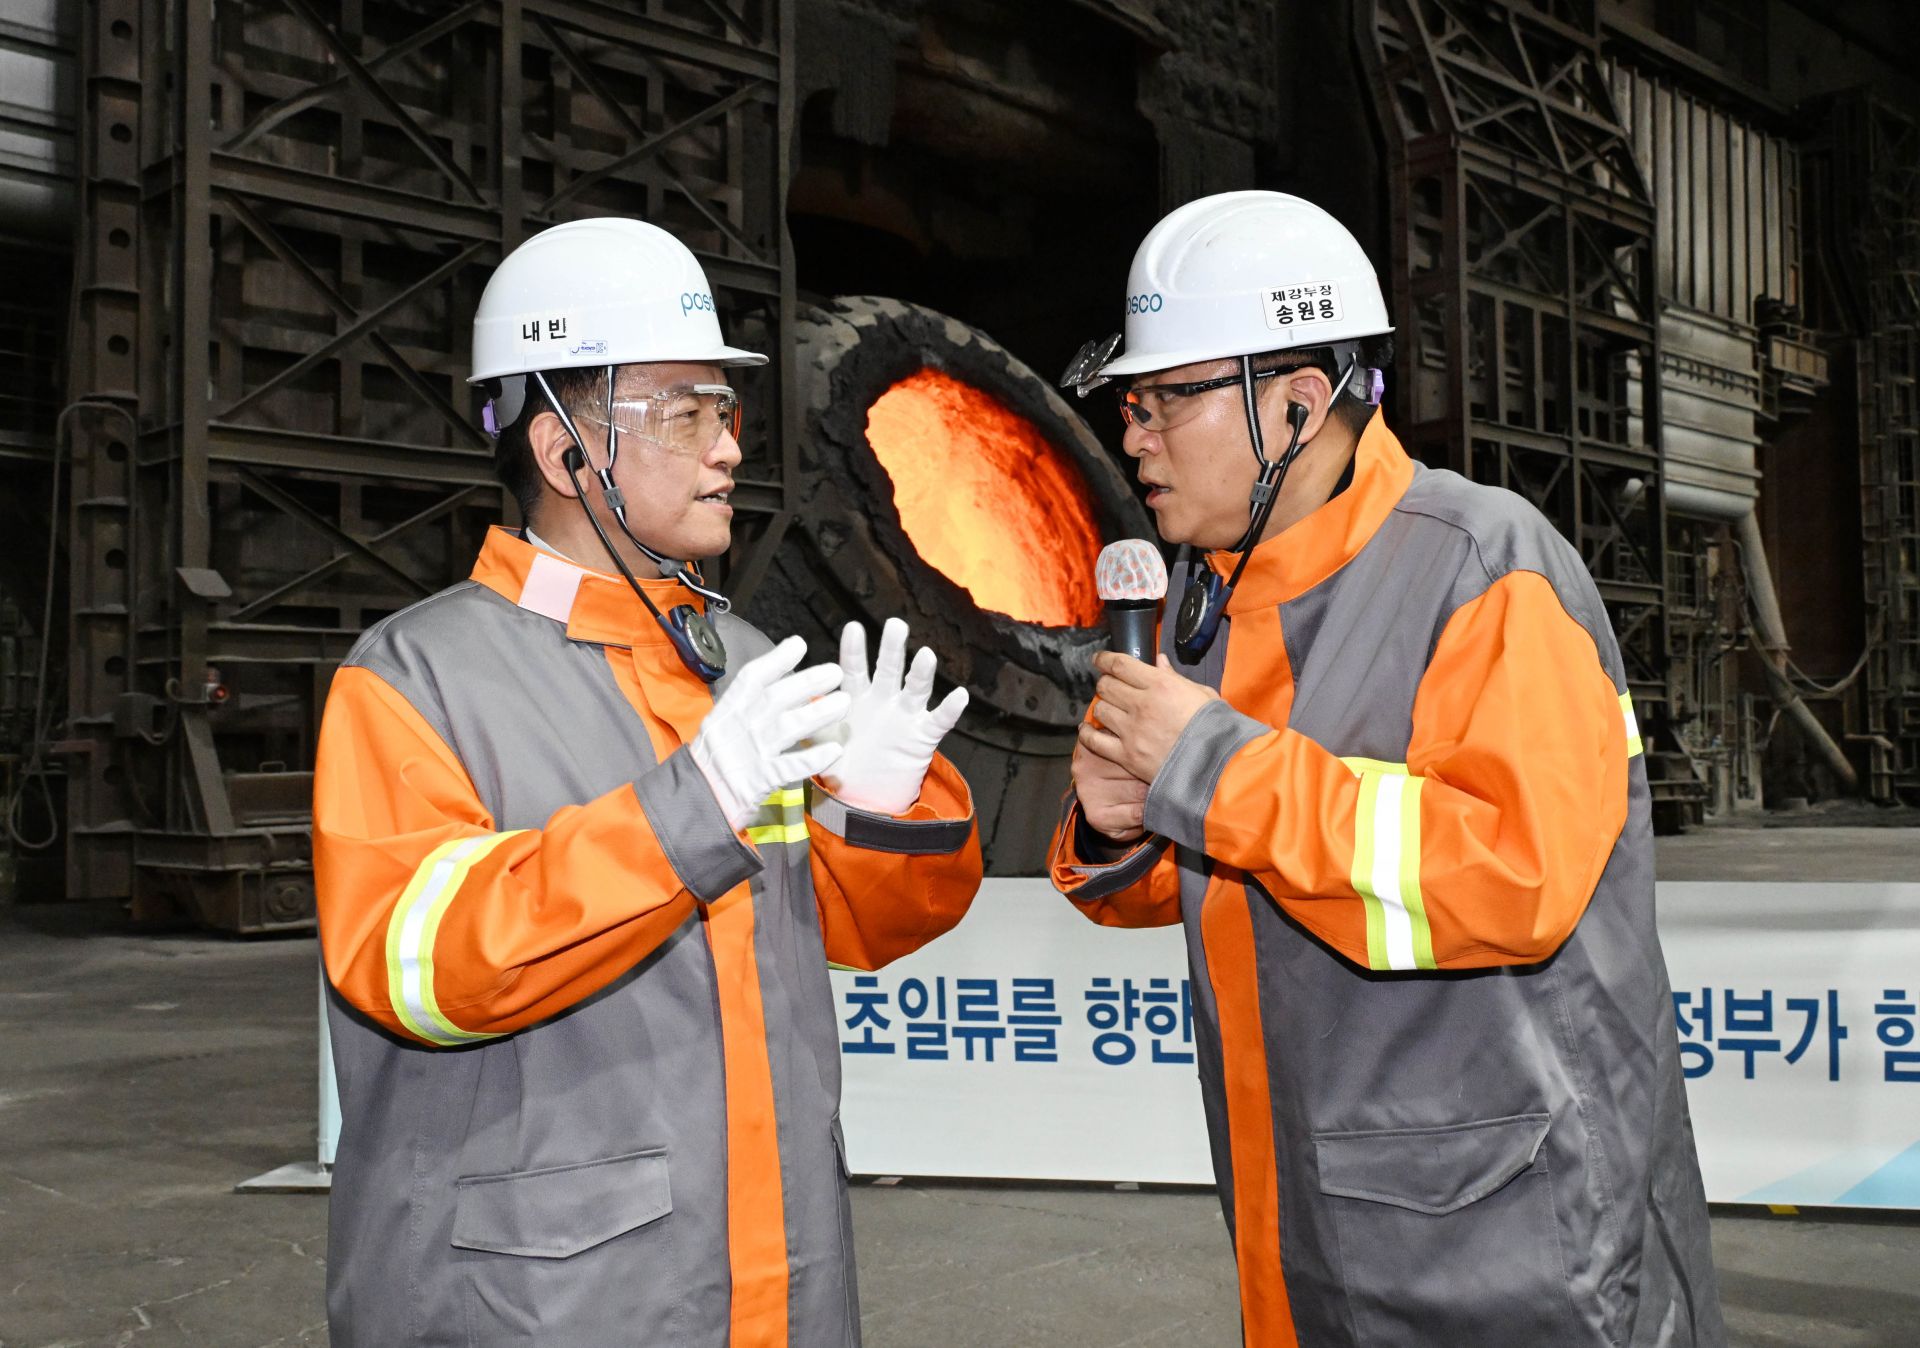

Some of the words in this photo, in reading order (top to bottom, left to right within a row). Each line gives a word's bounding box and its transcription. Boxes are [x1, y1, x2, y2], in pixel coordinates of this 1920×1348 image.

[1276, 299, 1334, 325] 송원용
[841, 976, 1062, 1063] 초일류를
[1085, 977, 1195, 1065] 향한
[1672, 987, 1848, 1082] 정부가
